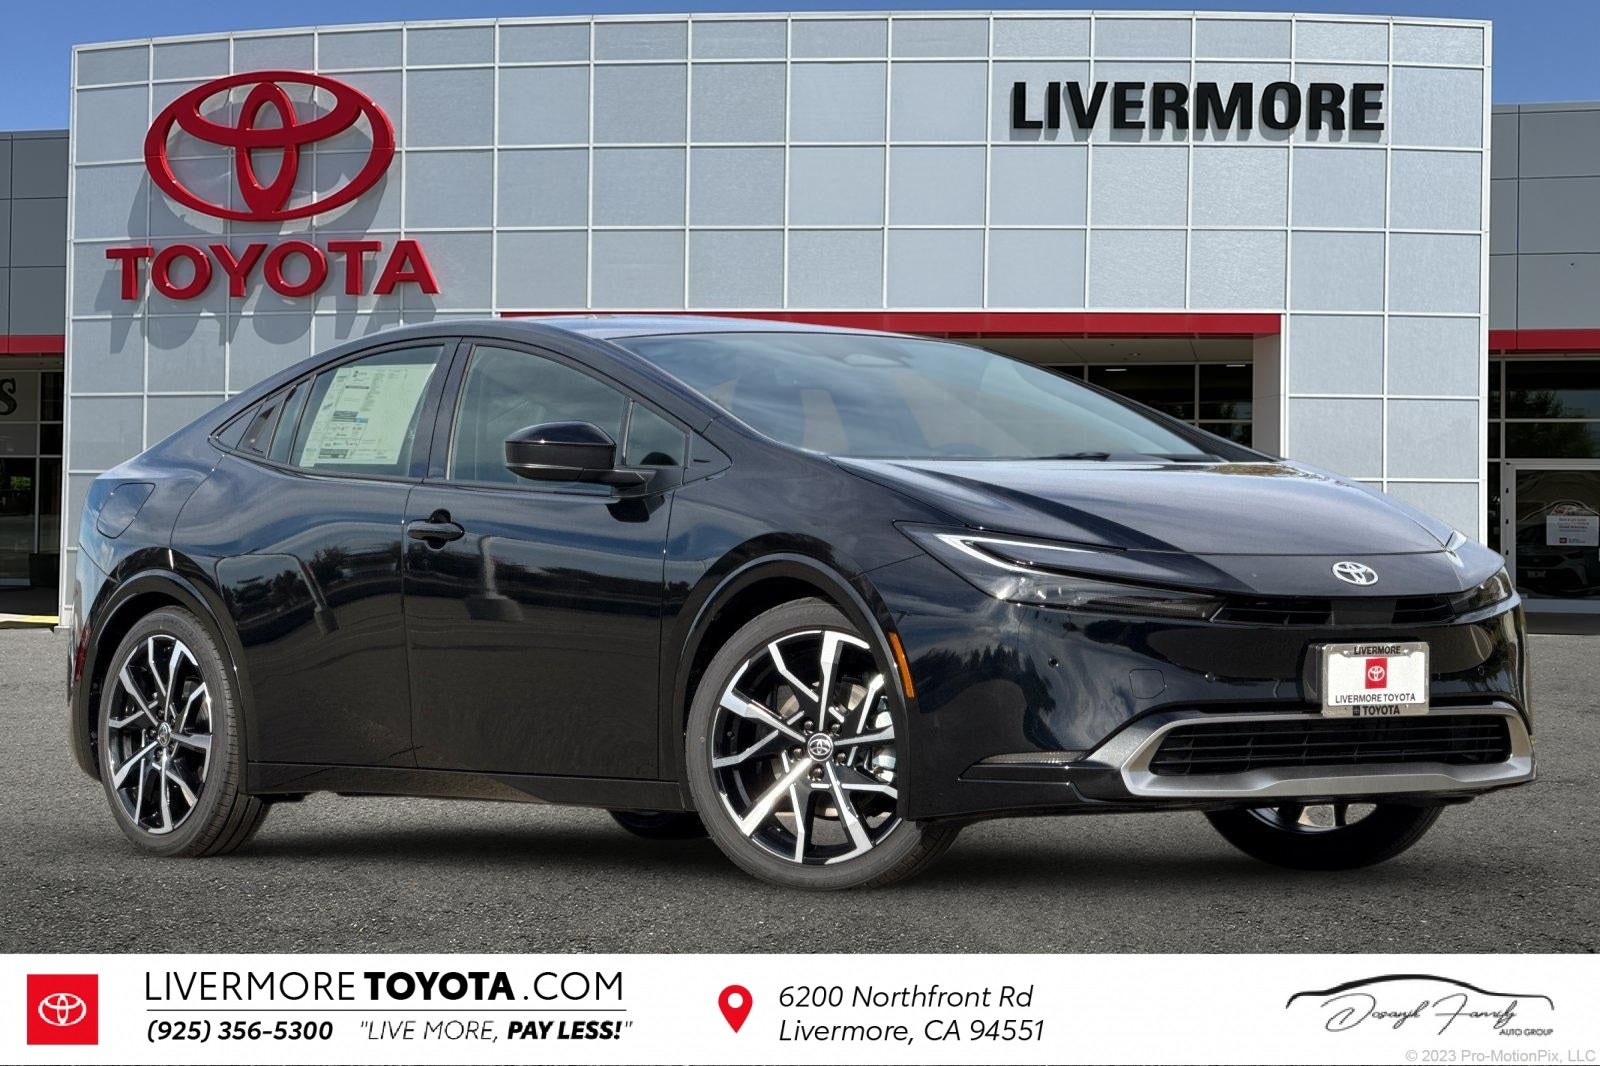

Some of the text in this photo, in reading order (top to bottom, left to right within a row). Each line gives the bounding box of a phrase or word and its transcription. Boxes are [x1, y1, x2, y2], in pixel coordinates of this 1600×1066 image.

[1012, 81, 1385, 131] LIVERMORE
[105, 240, 440, 299] TOYOTA
[1353, 645, 1402, 655] LIVERMORE
[1335, 693, 1416, 704] LIVERMORE TOYOTA
[1362, 705, 1401, 716] TOYOTA
